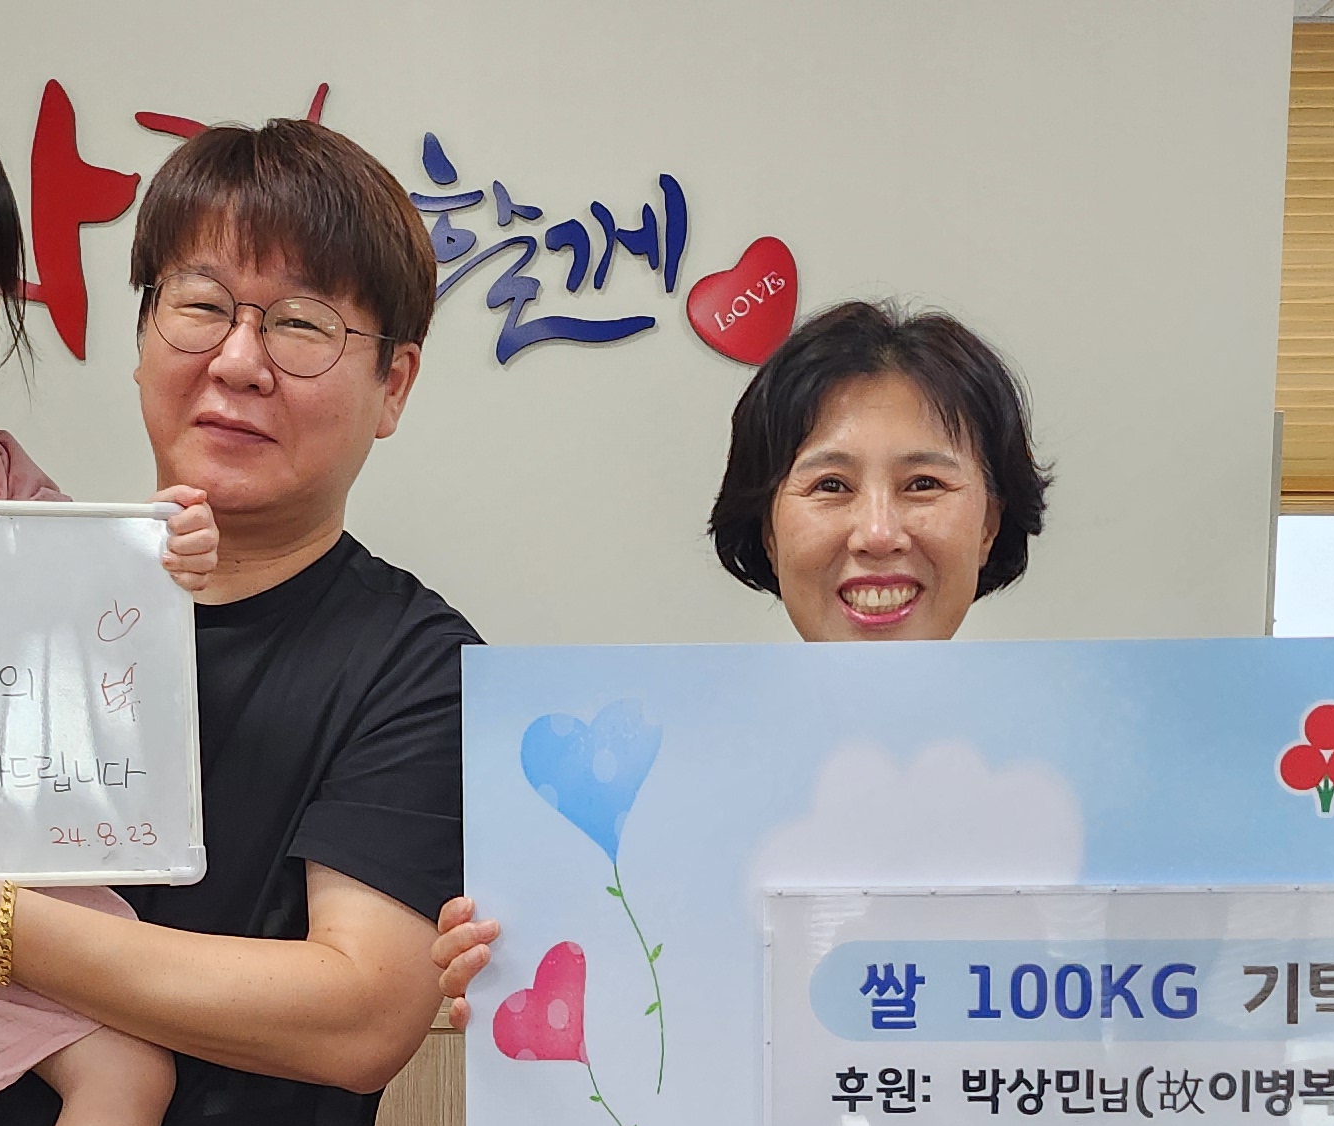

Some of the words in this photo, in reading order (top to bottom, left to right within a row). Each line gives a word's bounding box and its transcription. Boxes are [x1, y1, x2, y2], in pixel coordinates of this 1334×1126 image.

[714, 269, 787, 333] LOVE
[860, 961, 926, 1030] 쌀
[967, 963, 1199, 1021] 100KG
[831, 1066, 932, 1115] 후원:
